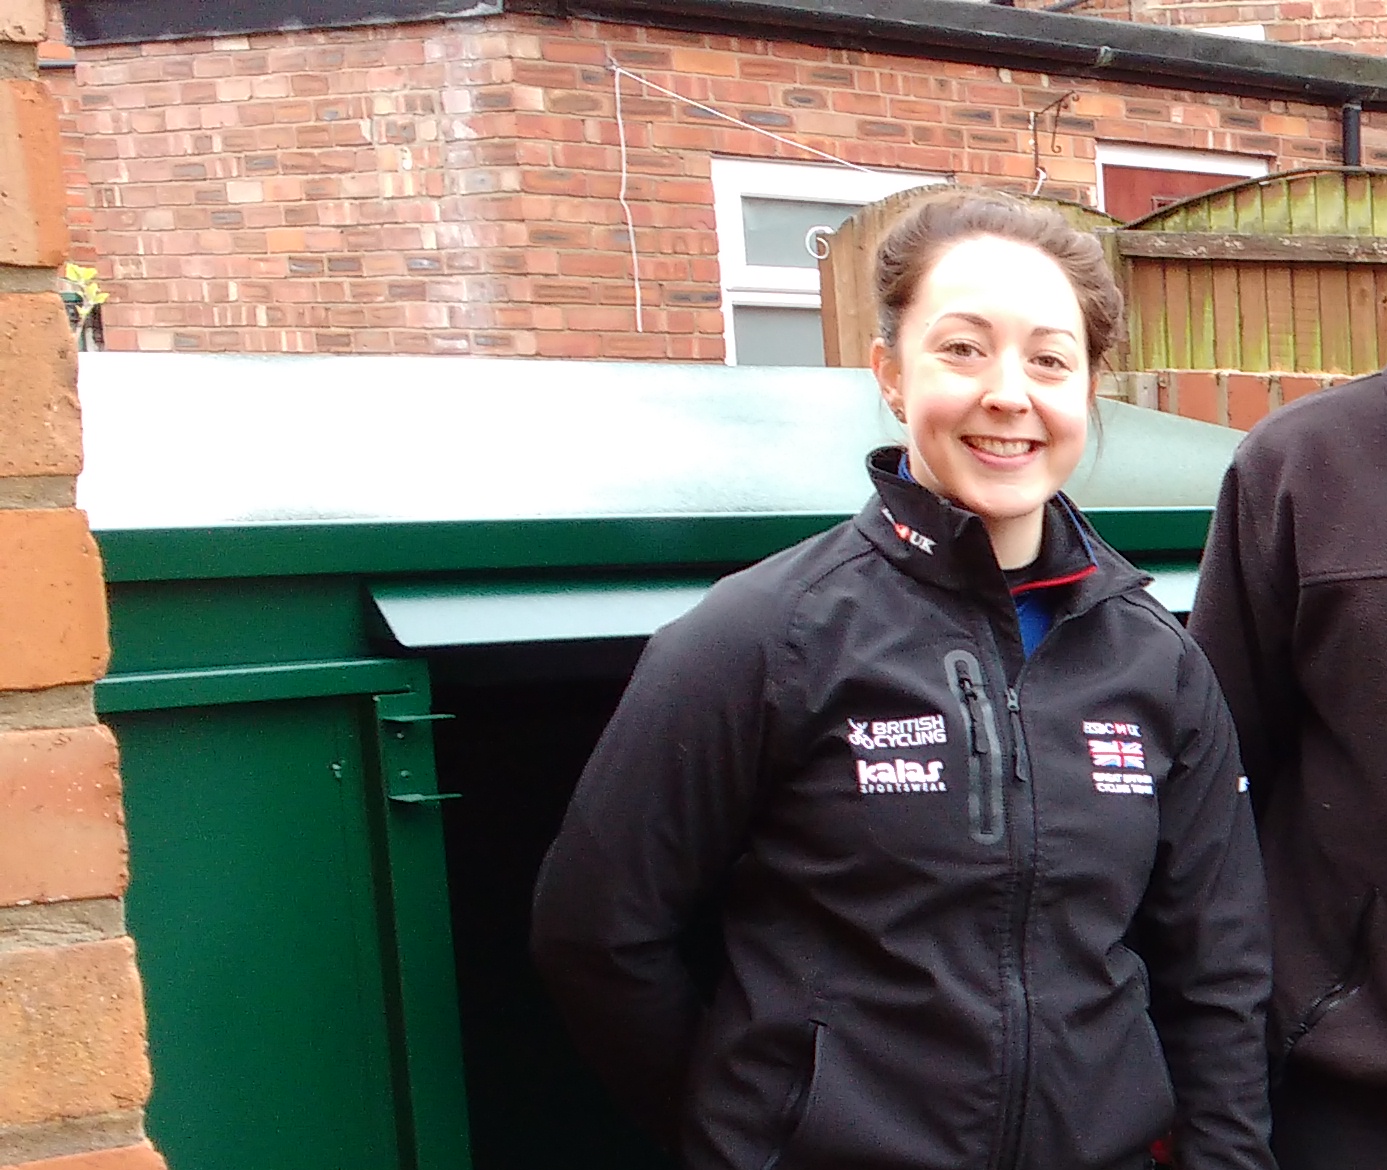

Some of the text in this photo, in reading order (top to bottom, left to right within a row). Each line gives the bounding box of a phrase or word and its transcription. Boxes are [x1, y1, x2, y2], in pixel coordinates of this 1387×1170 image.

[905, 526, 938, 556] UK
[873, 714, 946, 735] BRITISH
[874, 729, 947, 748] CYCLING
[857, 758, 944, 785] kalas
[859, 782, 947, 794] SPORTSWEAR
